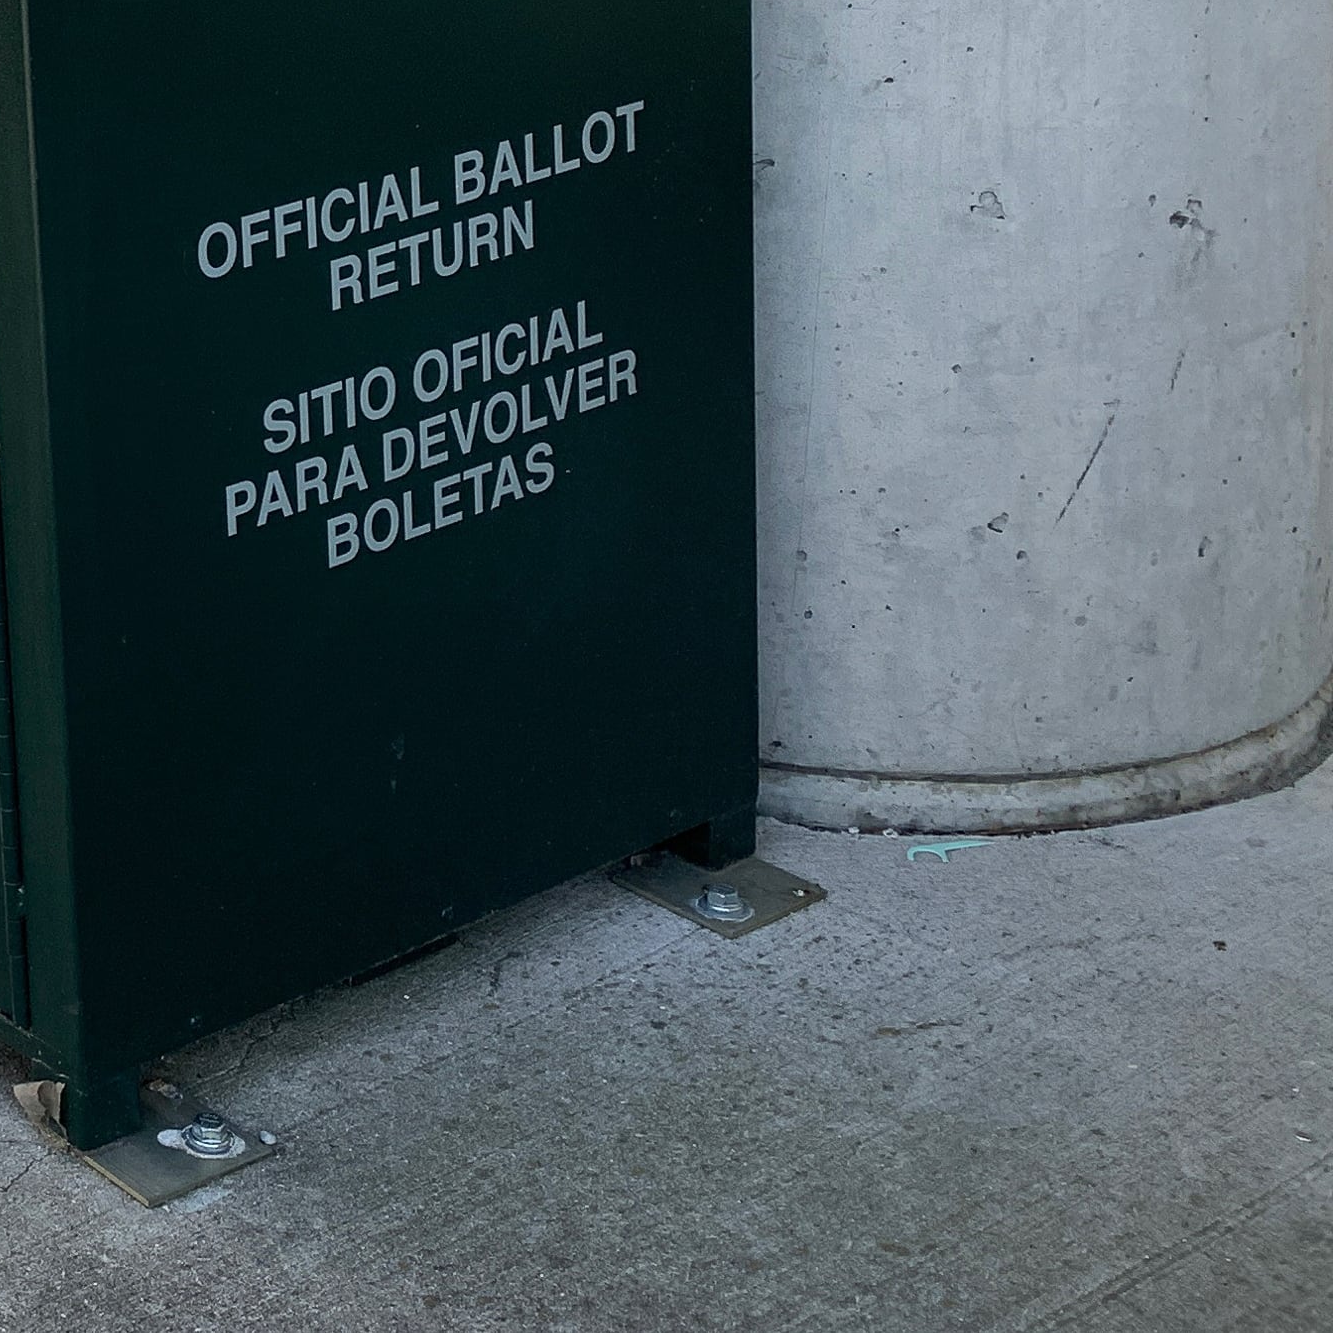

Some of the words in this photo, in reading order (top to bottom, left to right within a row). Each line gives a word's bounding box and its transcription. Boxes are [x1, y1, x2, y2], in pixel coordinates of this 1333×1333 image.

[198, 166, 439, 278] OFFICIAL
[454, 100, 645, 205] BALLOT
[330, 199, 534, 311] RETURN
[225, 444, 369, 537] PARA
[383, 349, 638, 482] DEVOLVER
[263, 366, 396, 454] SITIO
[413, 300, 603, 402] OFICIAL
[327, 442, 554, 568] BOLETAS
